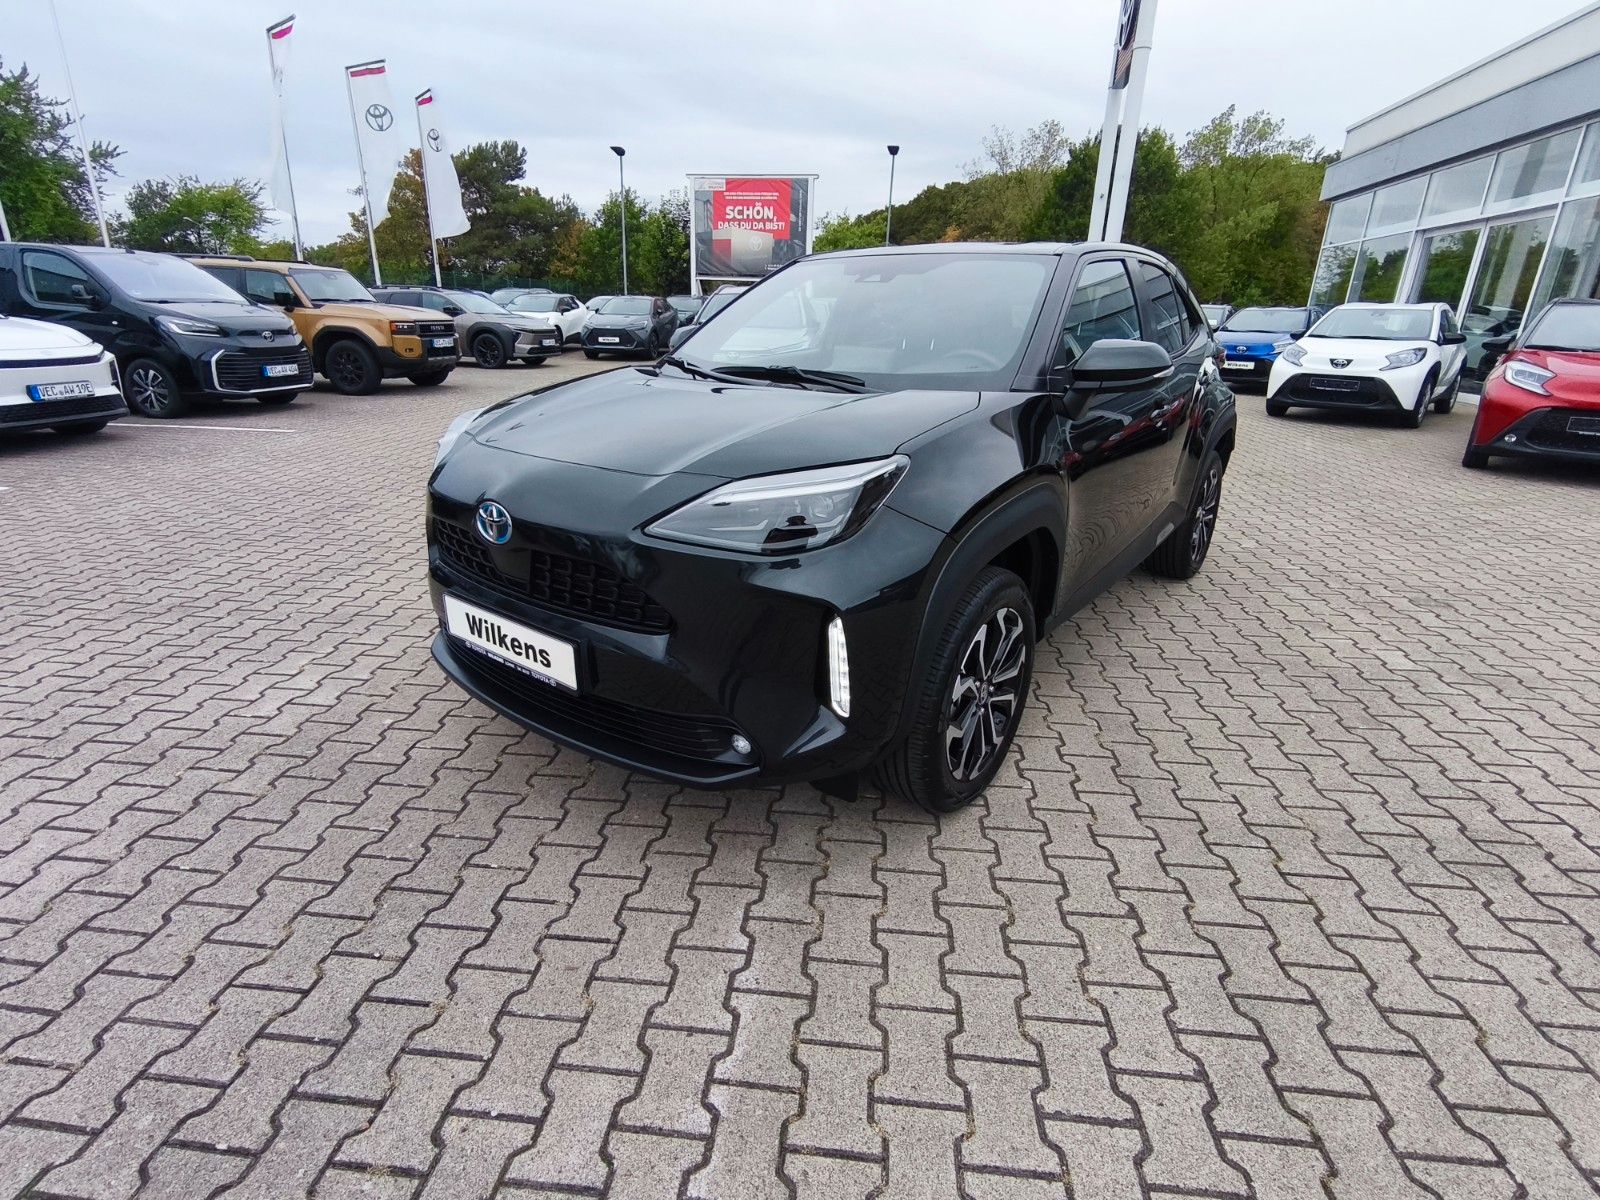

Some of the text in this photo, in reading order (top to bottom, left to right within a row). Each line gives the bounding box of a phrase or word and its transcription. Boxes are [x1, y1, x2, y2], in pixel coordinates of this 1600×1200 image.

[725, 202, 777, 222] SCHÖN,
[718, 221, 785, 230] DASS DU DA BIST!
[38, 383, 93, 397] VEC AW 19E
[465, 612, 552, 669] Wilkens
